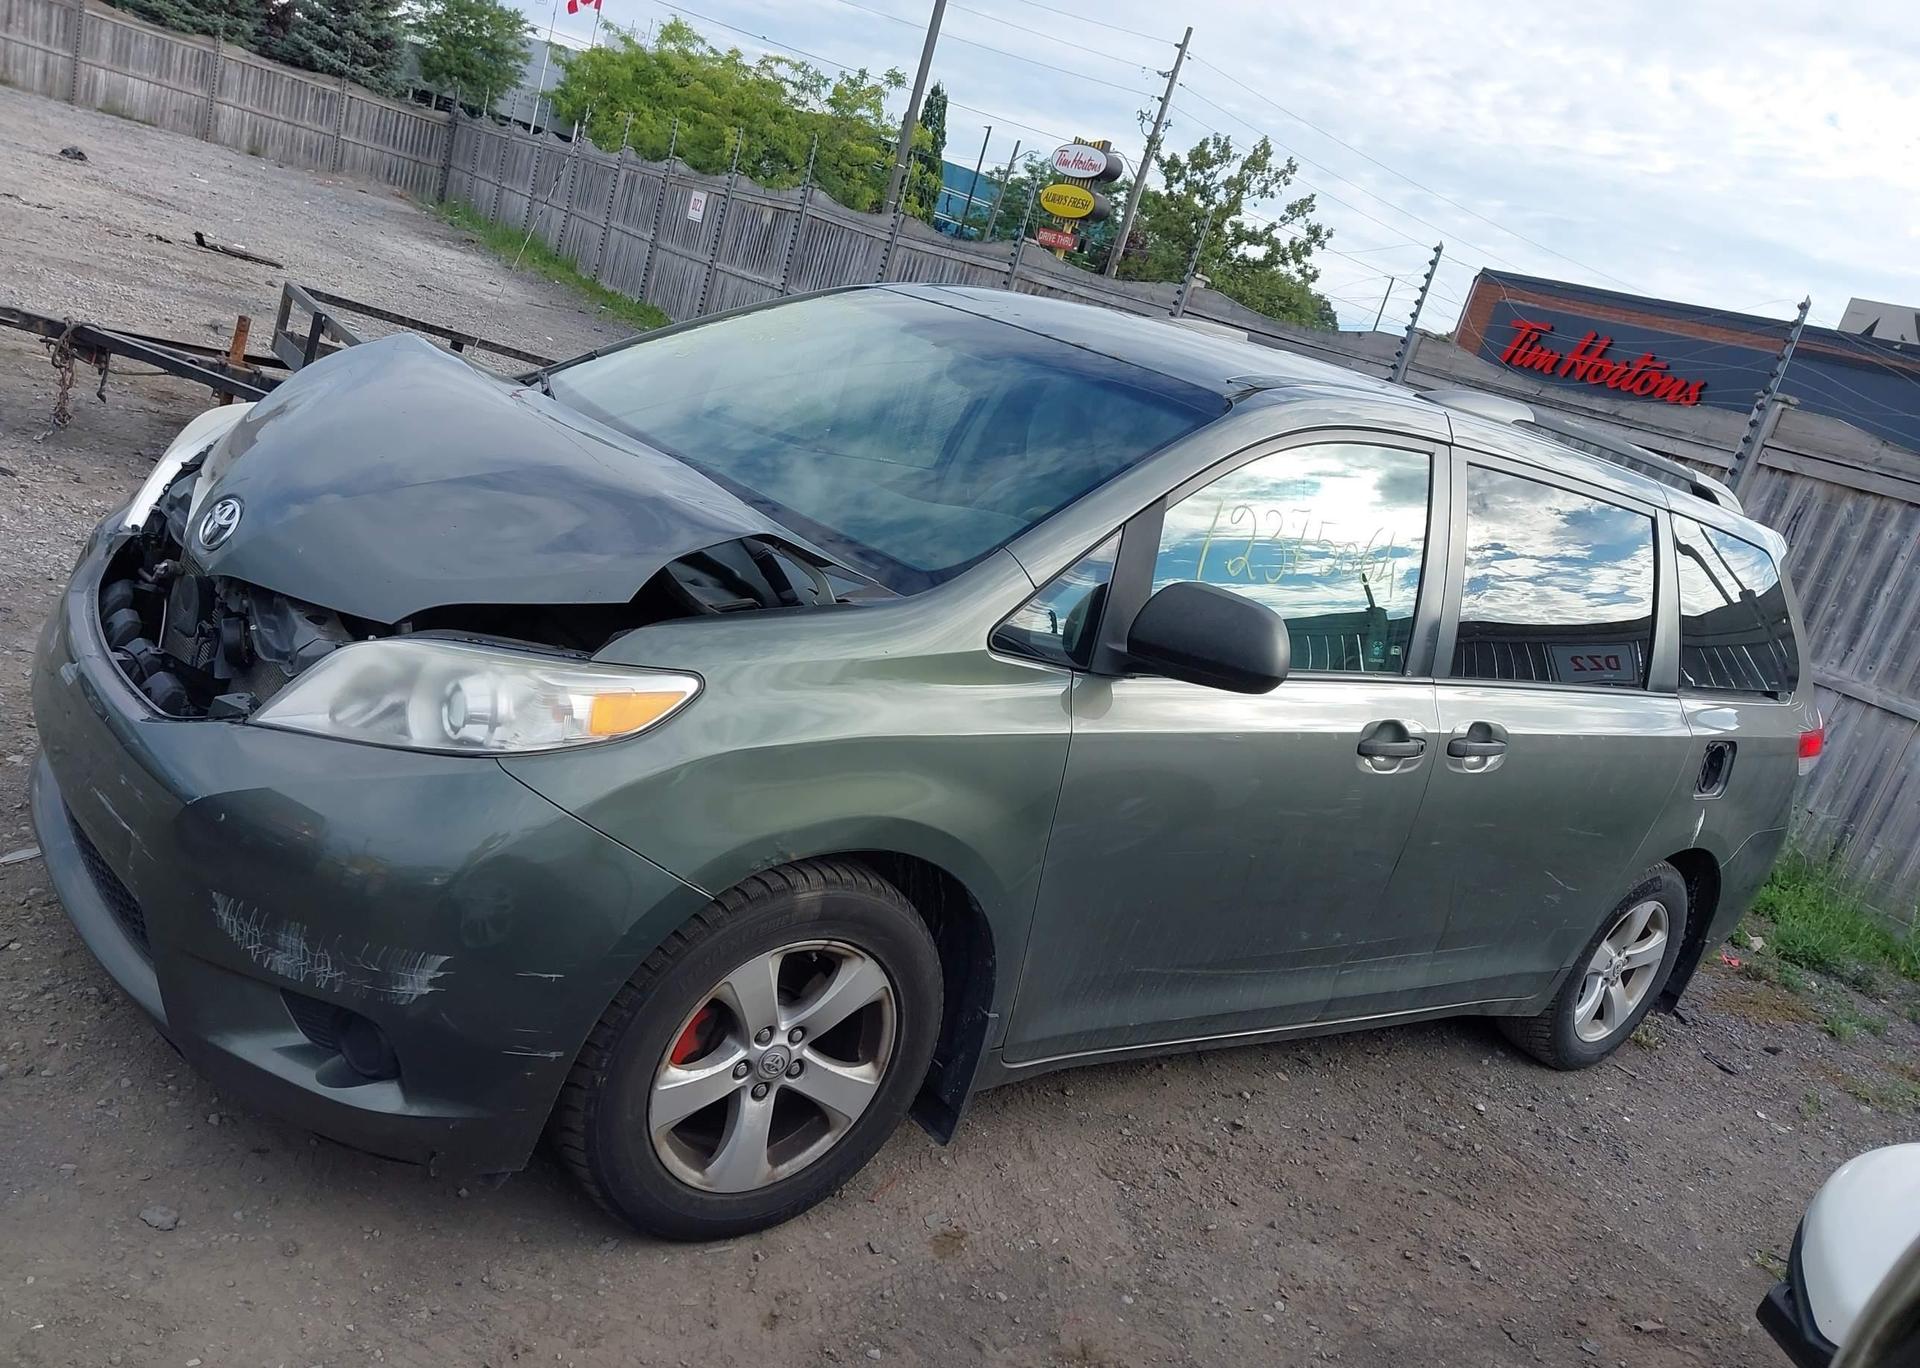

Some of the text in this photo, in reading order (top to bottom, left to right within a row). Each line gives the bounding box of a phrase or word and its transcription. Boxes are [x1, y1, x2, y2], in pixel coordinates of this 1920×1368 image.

[1055, 150, 1102, 172] Tim Hortons
[1043, 192, 1092, 210] ALWAYS FRESH
[1039, 231, 1074, 247] DRIVE THRU
[1501, 319, 1706, 407] Tim Hortons
